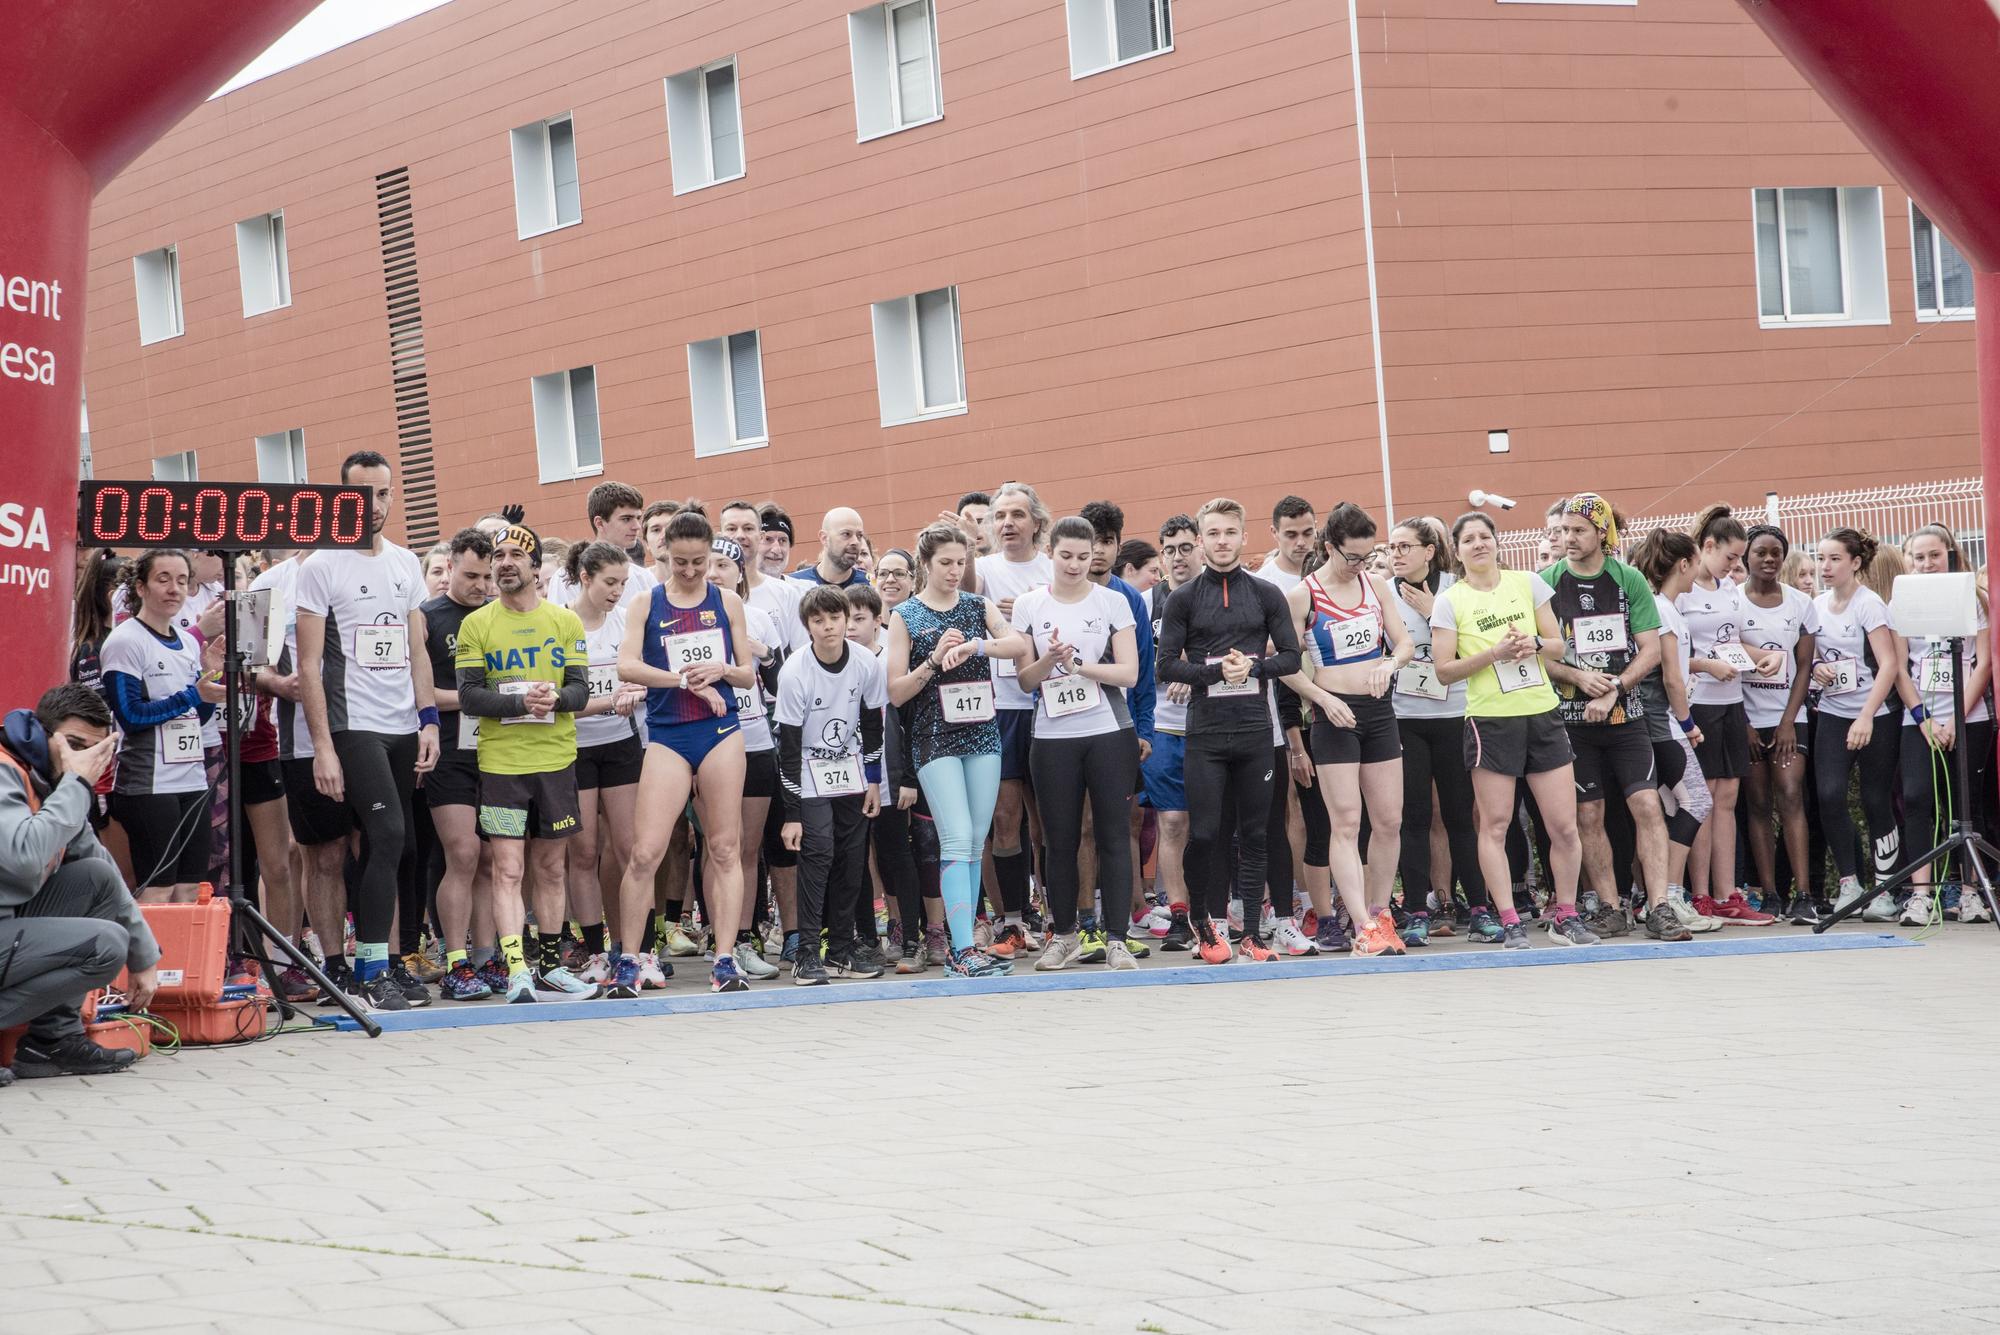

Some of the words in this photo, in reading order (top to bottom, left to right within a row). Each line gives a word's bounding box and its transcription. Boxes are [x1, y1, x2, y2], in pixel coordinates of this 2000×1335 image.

[94, 487, 364, 543] 00:00:00
[0, 502, 51, 552] SA
[1345, 629, 1371, 647] 226
[1587, 628, 1613, 642] 438
[374, 641, 392, 656] 57
[682, 645, 712, 662] 398
[1728, 653, 1747, 664] 333
[1518, 664, 1528, 678] 6
[588, 679, 613, 695] 214
[1418, 675, 1428, 688] 7
[1750, 682, 1790, 690] MANRESA
[1057, 688, 1086, 705] 418
[956, 697, 982, 712] 417
[824, 770, 850, 784] 374
